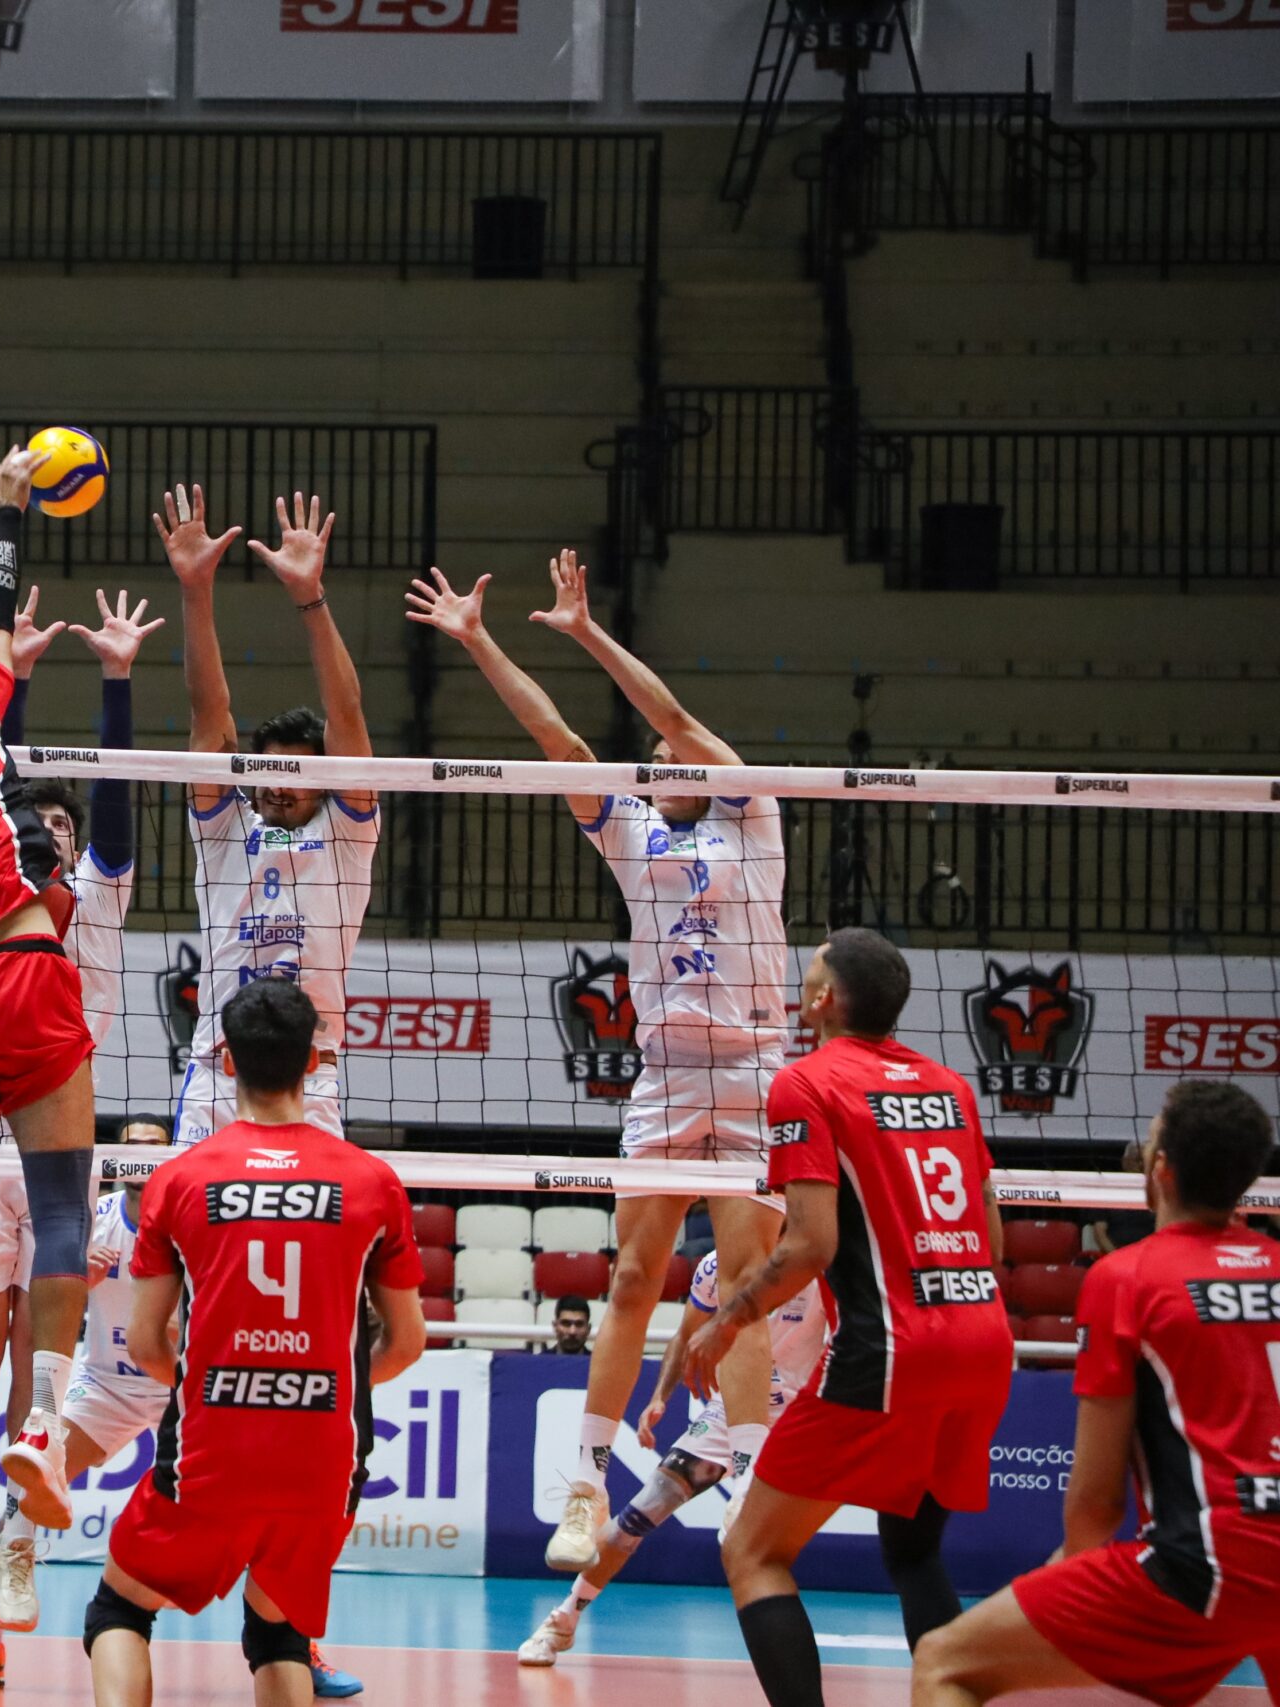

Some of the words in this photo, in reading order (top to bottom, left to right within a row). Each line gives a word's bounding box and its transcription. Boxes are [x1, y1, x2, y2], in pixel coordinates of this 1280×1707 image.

[803, 22, 888, 49] SESI
[45, 749, 100, 764] SUPERLIGA
[246, 758, 301, 774] SUPERLIGA
[448, 765, 503, 779] SUPERLIGA
[652, 768, 708, 783] SUPERLIGA
[860, 772, 917, 788] SUPERLIGA
[1071, 778, 1129, 793] SUPERLIGA
[263, 867, 280, 899] 8
[679, 859, 710, 896] 18
[345, 1001, 476, 1049] SESI
[573, 1052, 635, 1078] SES
[985, 1066, 1070, 1095] SESI
[880, 1095, 958, 1131] SESI
[245, 1158, 301, 1169] PENALTY
[552, 1174, 614, 1190] SUPERLIGA
[904, 1146, 969, 1223] 13
[219, 1183, 332, 1221] SESI
[998, 1189, 1062, 1203] SUPERLIGA
[247, 1239, 302, 1320] 4
[919, 1270, 999, 1303] FIESP
[233, 1328, 311, 1355] PEDRO
[209, 1370, 331, 1407] FIESP
[988, 1472, 1051, 1490] nosso
[351, 1514, 461, 1550] nline
